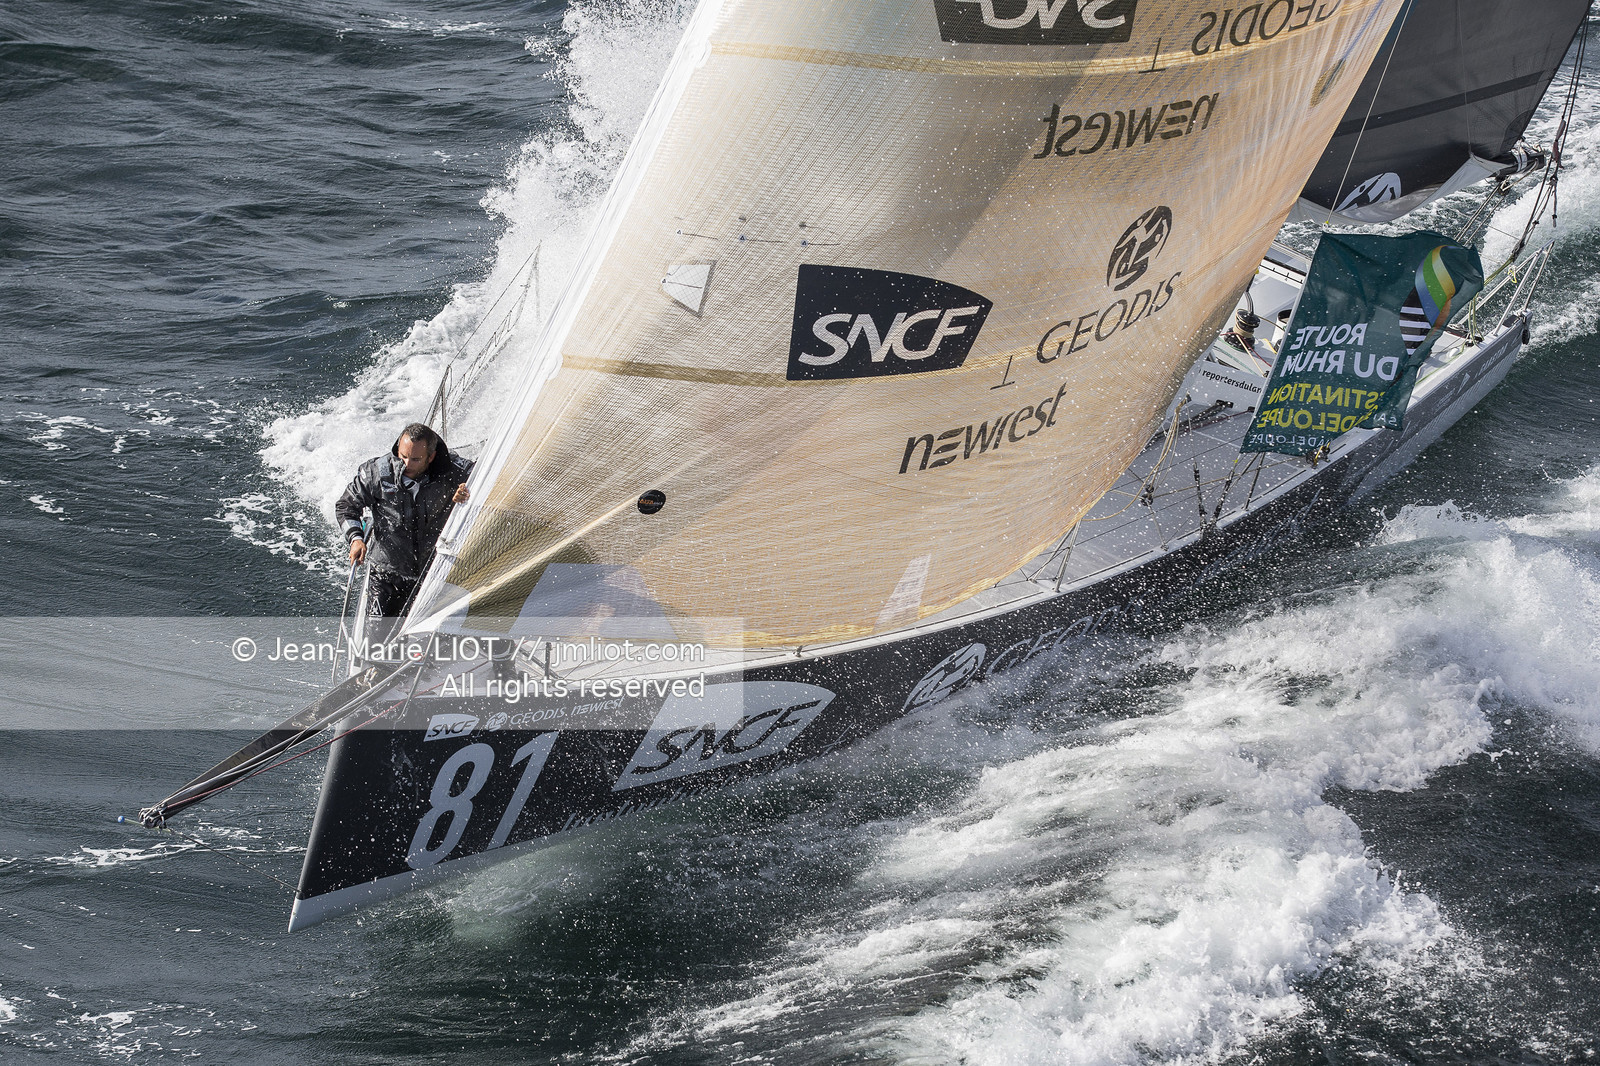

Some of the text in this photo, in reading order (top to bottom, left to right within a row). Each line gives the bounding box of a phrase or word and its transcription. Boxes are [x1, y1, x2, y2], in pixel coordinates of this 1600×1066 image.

[798, 305, 980, 366] SNCF
[1036, 271, 1182, 364] GEODIS
[1202, 369, 1262, 394] reportersdular
[427, 720, 476, 738] SNCF
[510, 707, 565, 726] GEODIS
[630, 699, 823, 774] SNCF
[405, 730, 559, 871] 81
